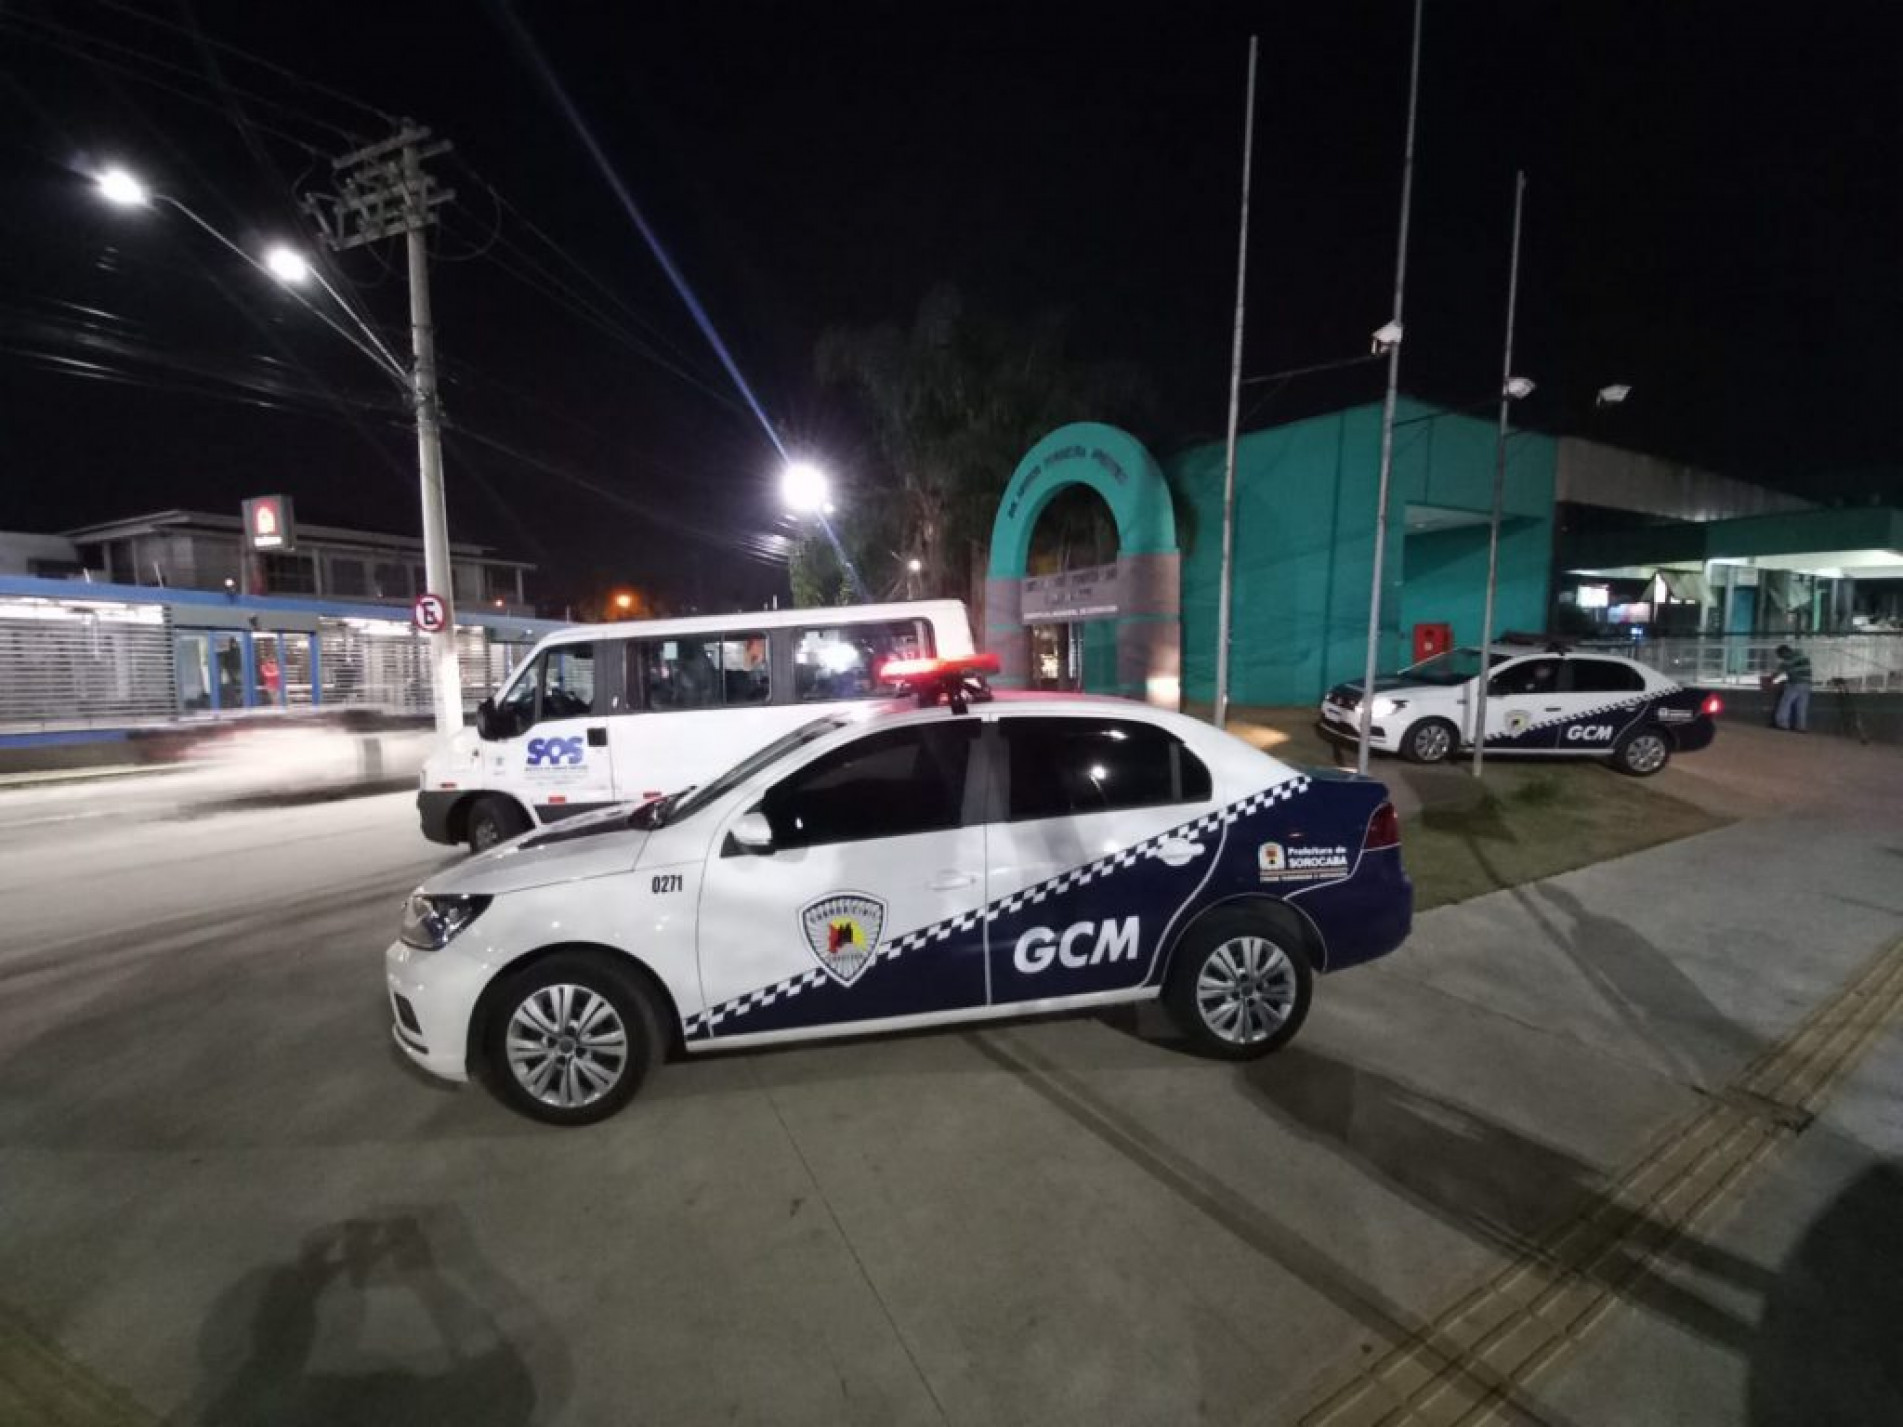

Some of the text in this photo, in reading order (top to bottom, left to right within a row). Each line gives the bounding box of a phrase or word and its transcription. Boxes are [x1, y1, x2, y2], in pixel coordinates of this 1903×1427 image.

[1567, 725, 1613, 740] GCM
[526, 736, 584, 766] SOS
[1289, 856, 1348, 868] SOROCABA
[652, 875, 683, 894] 0271
[1014, 915, 1140, 974] GCM
